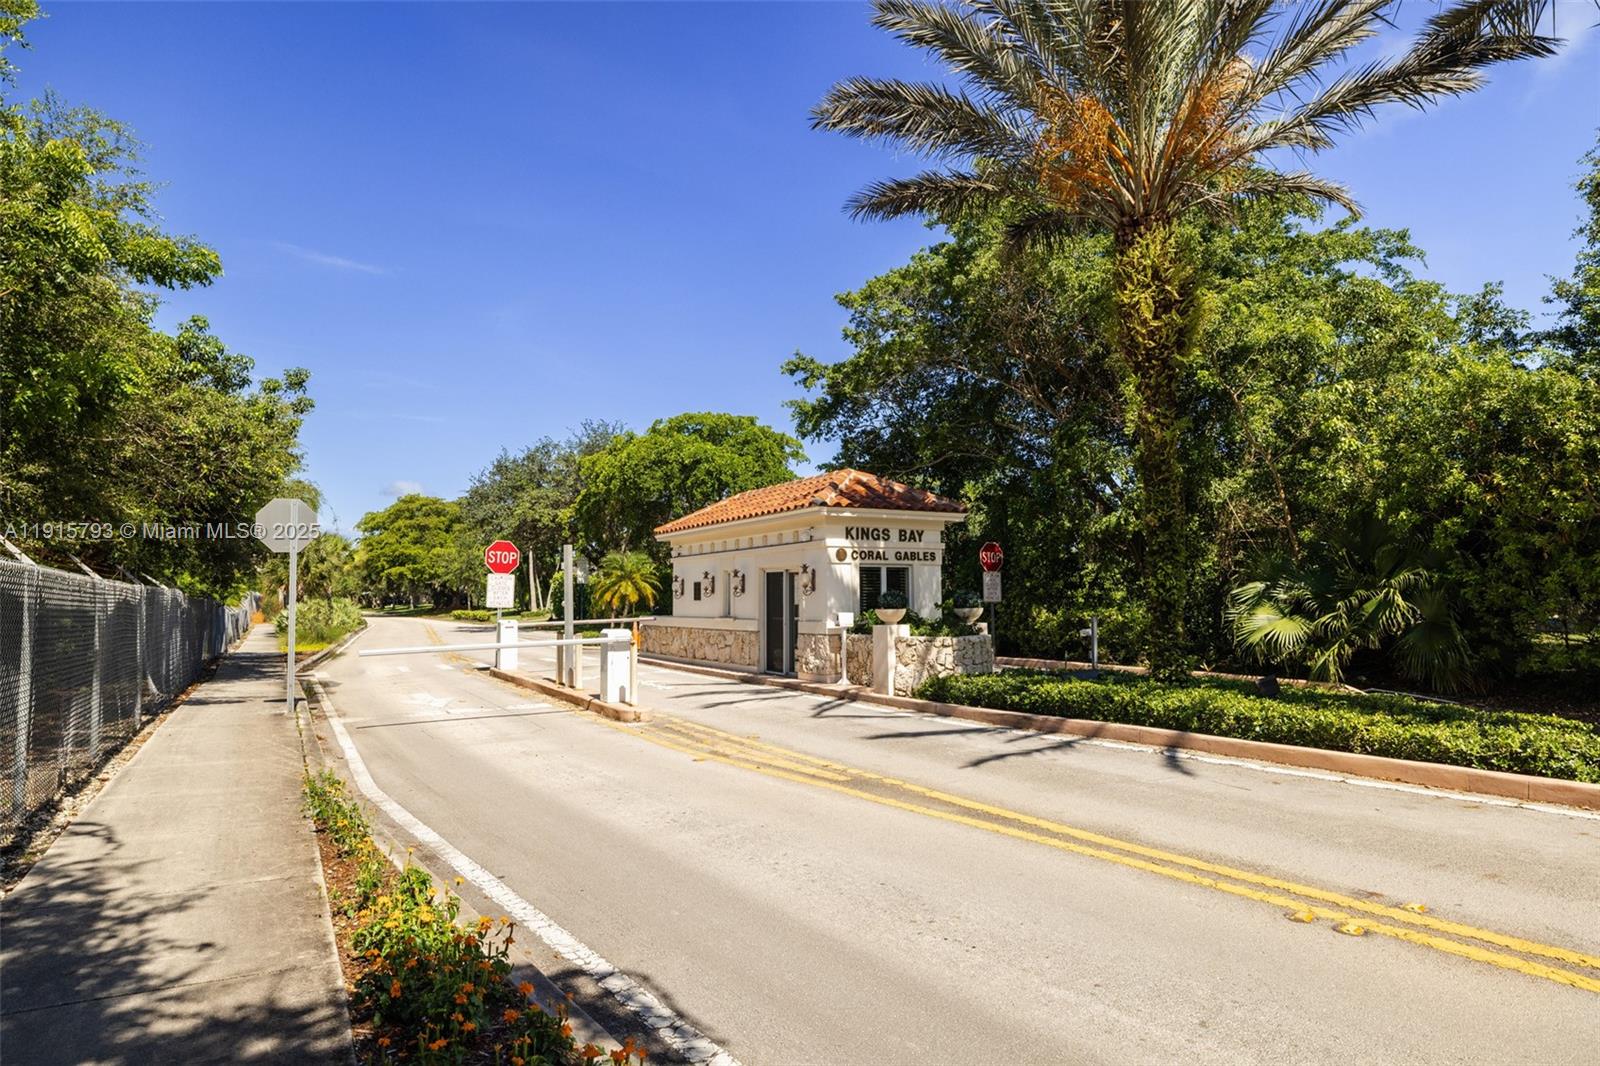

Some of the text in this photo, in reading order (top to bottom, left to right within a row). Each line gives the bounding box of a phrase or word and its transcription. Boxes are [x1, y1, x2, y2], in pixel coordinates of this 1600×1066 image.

[845, 526, 925, 542] KINGS BAY
[488, 550, 517, 564] STOP
[851, 550, 936, 561] CORAL GABLES
[982, 551, 1001, 563] STOP
